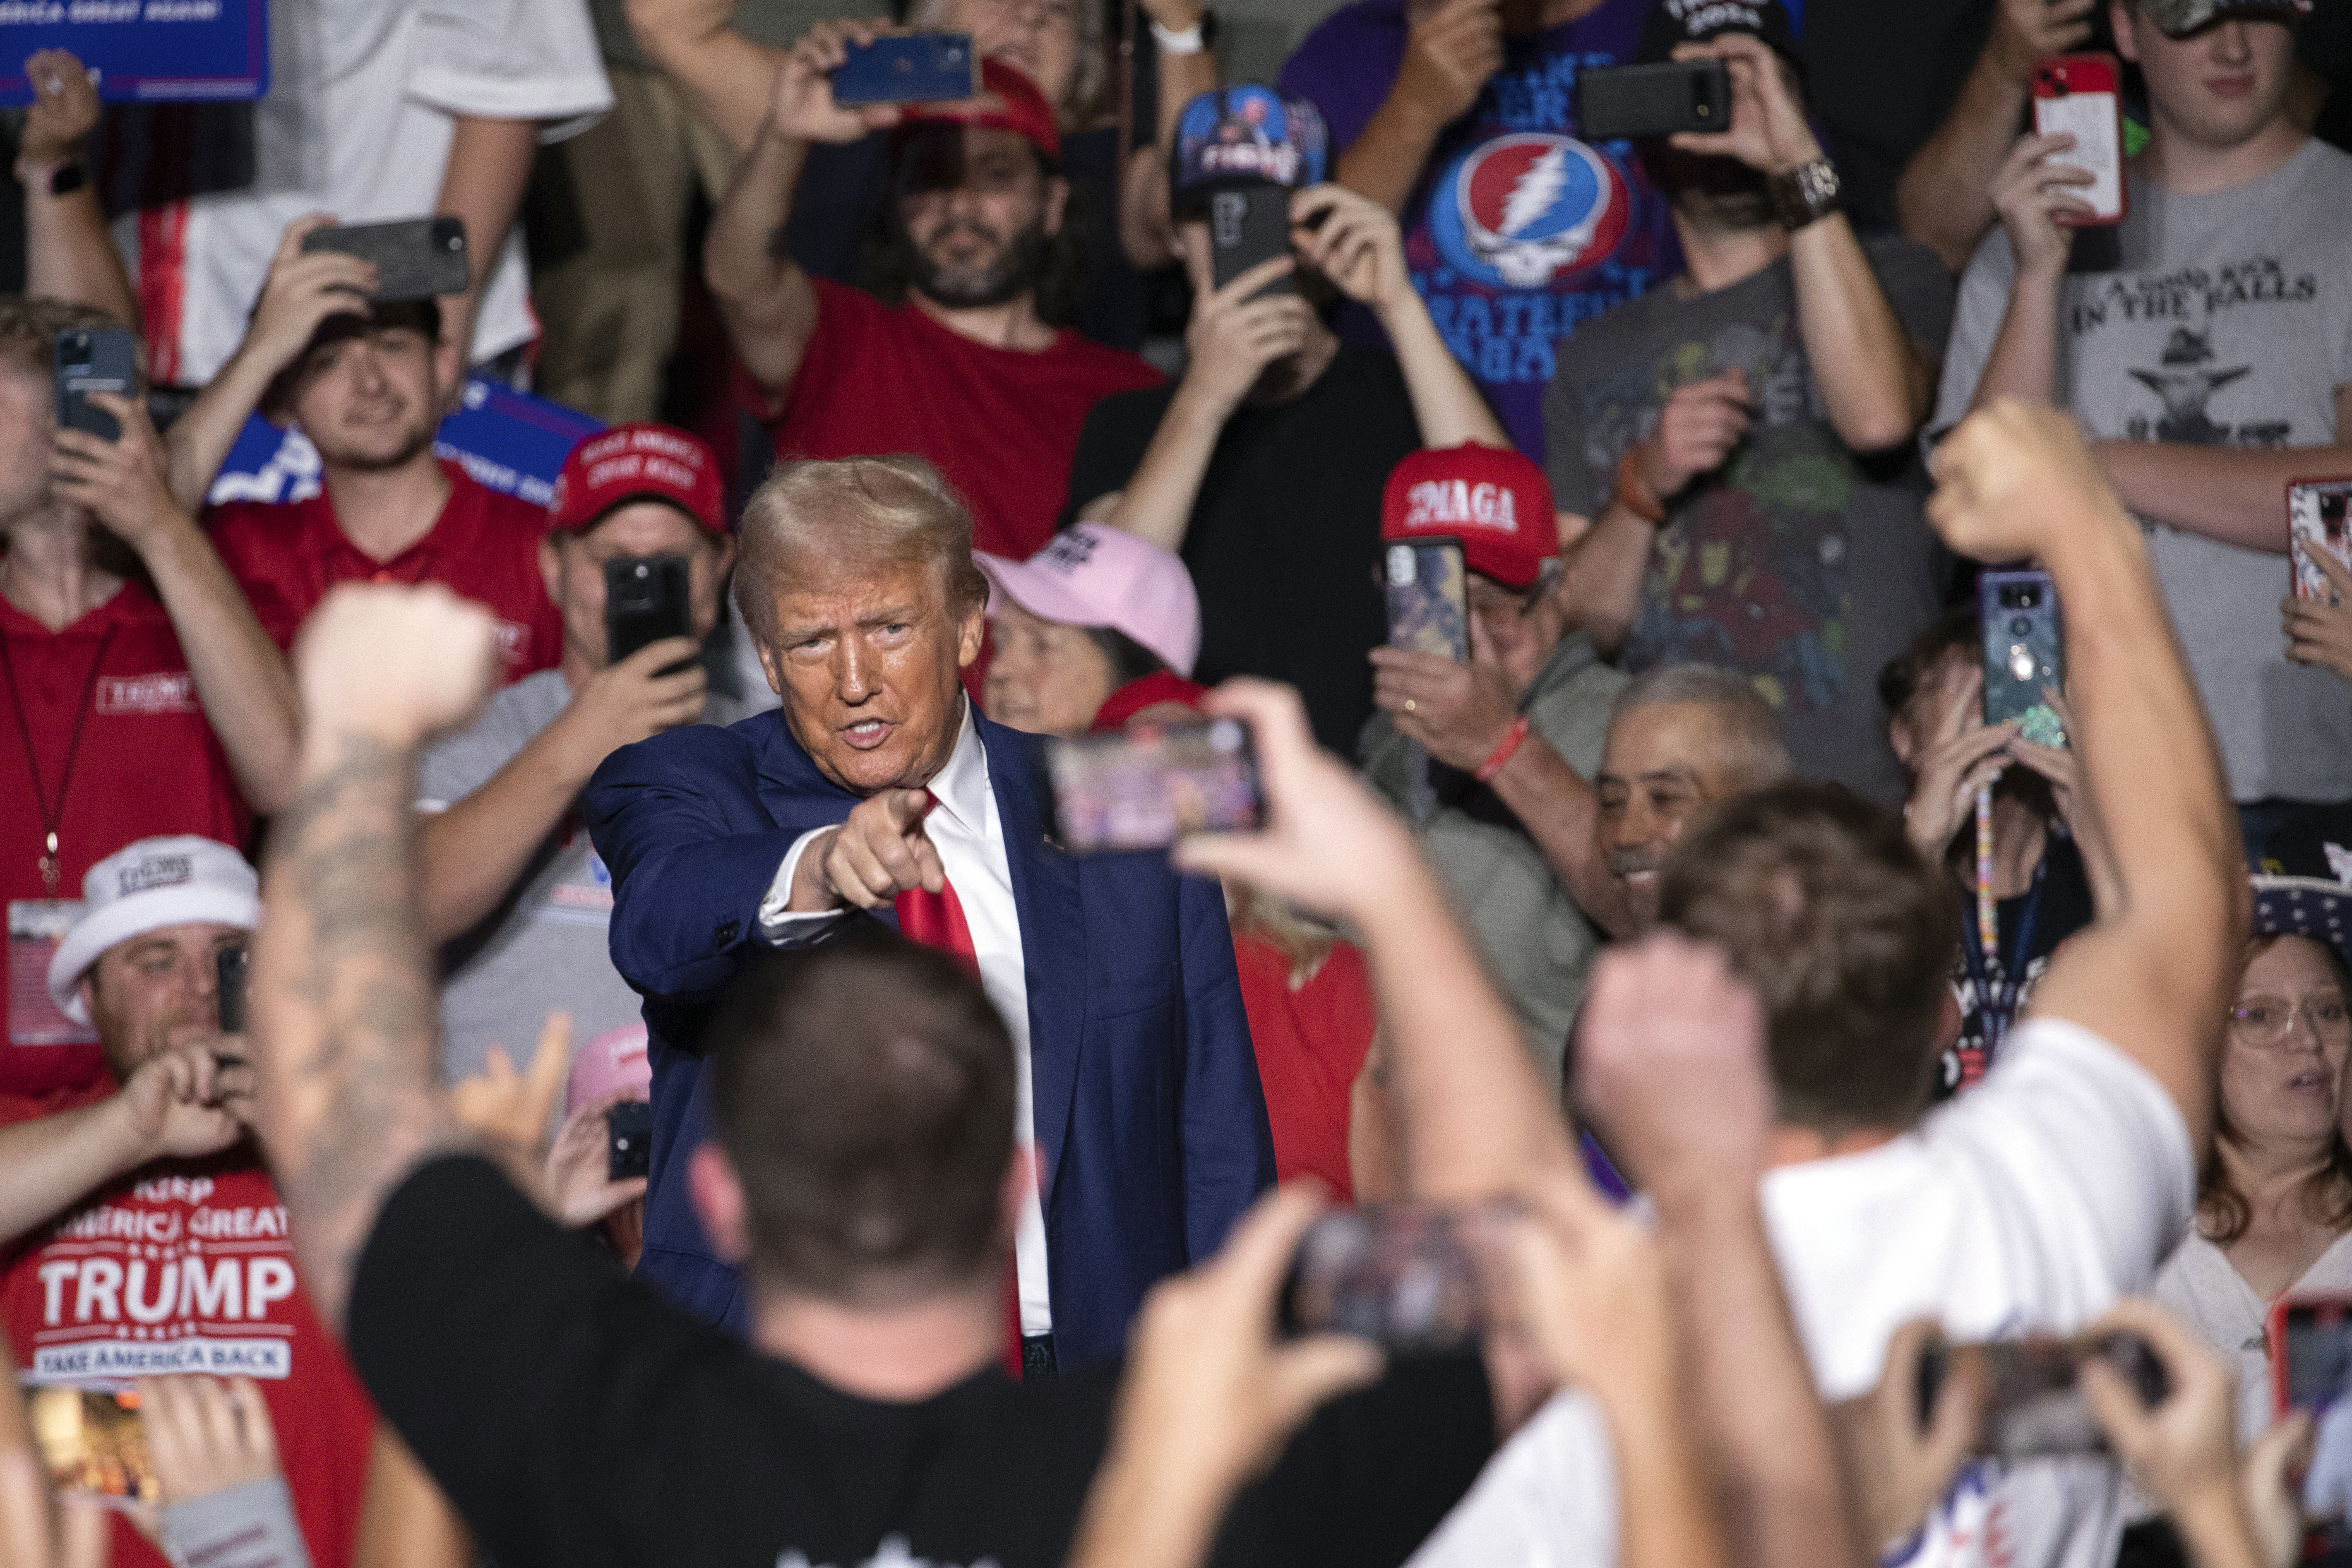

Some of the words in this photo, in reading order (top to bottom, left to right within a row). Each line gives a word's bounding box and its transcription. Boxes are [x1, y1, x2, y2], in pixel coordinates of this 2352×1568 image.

[2072, 301, 2107, 334] IN
[2122, 290, 2193, 319] THE
[2205, 271, 2318, 315] BALLS
[38, 1254, 296, 1326] TRUMP
[43, 1354, 89, 1374] TAKE
[96, 1344, 204, 1371] AMERICA
[210, 1345, 279, 1368] BACK
